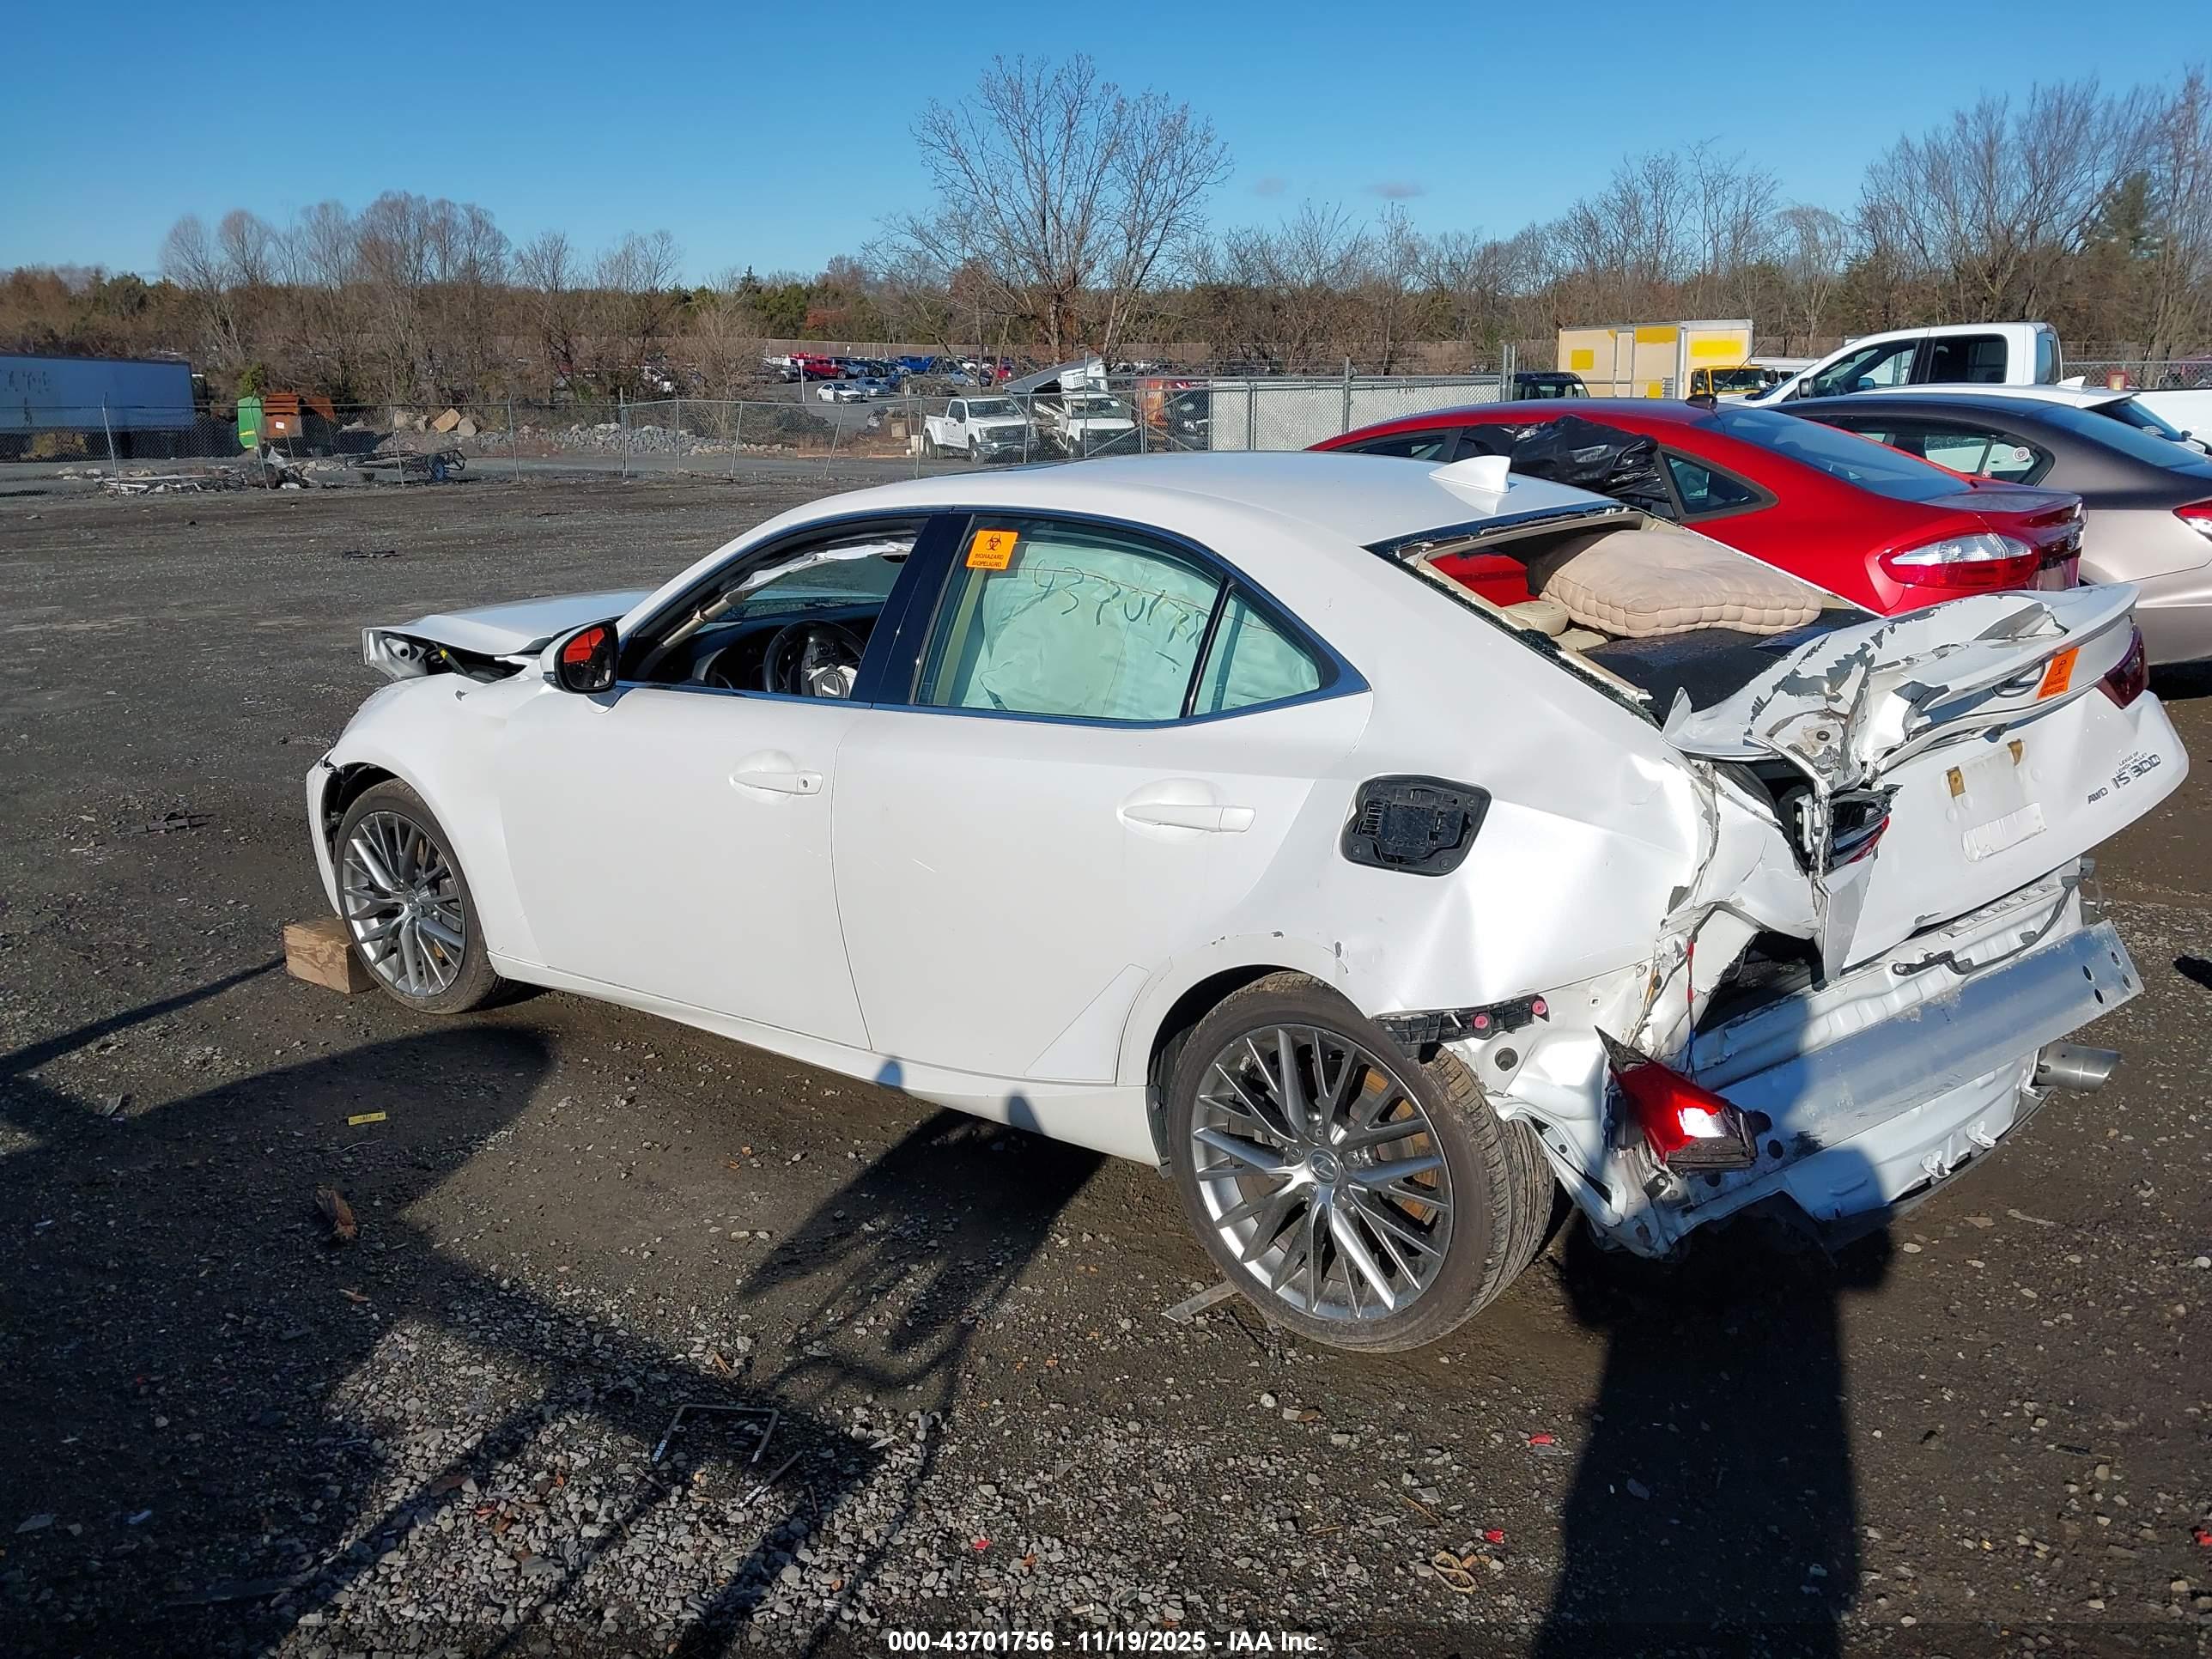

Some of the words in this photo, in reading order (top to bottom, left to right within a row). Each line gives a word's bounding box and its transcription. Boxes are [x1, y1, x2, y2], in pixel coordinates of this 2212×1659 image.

[2087, 787, 2109, 804] AWD
[2112, 771, 2131, 789] IS
[2130, 754, 2161, 778] 300
